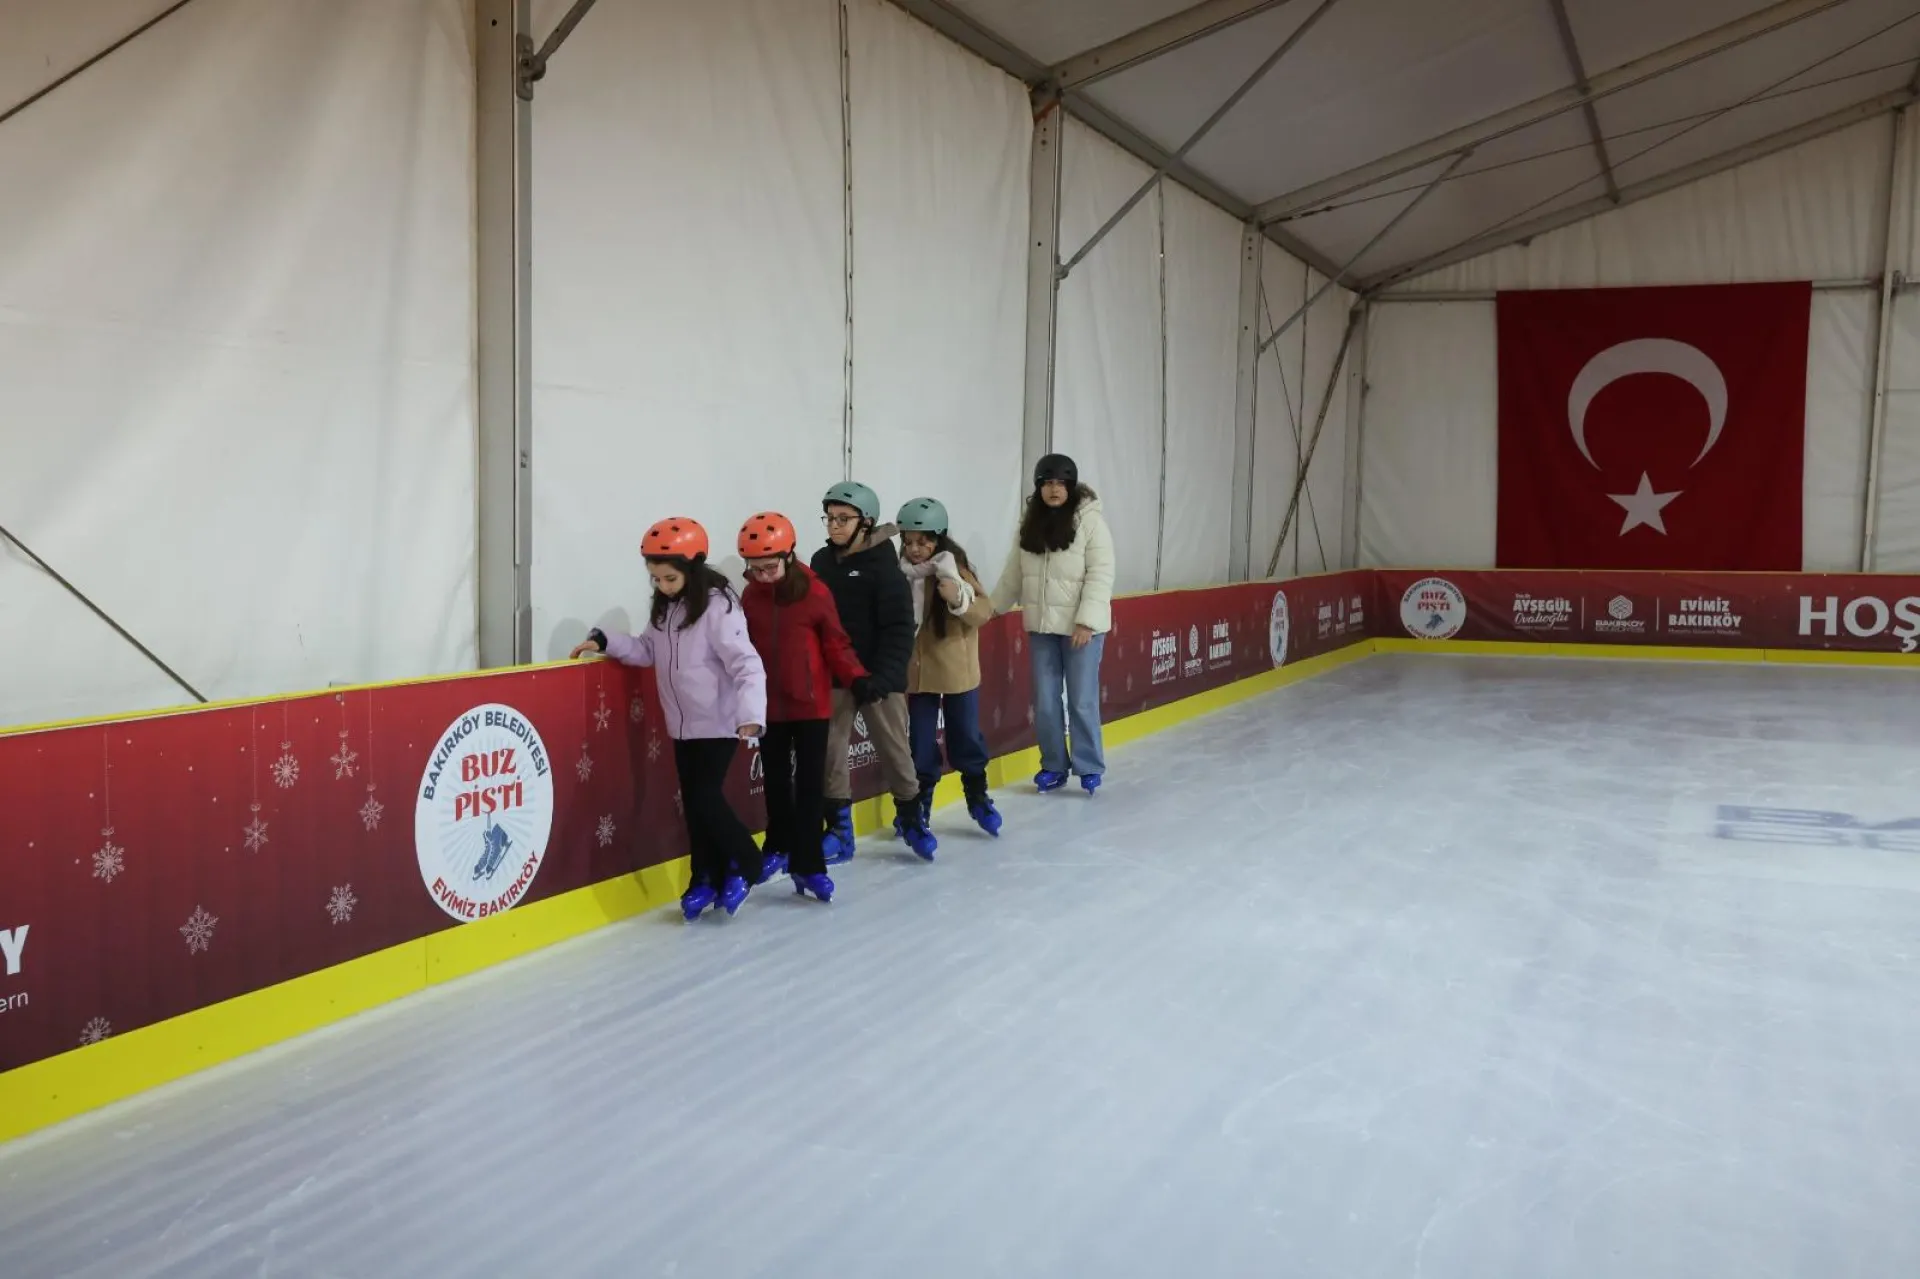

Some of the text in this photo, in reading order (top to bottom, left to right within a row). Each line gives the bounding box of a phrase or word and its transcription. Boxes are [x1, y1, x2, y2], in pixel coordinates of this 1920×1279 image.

[1513, 598, 1572, 614] AYŞEGÜL
[1668, 613, 1742, 628] BAKIRKÖY
[1680, 596, 1730, 612] EVİMİZ
[1798, 596, 1920, 653] HOŞ
[423, 711, 548, 800] BAKIRKÖY BELEDİYESİ
[462, 748, 516, 782] BUZ
[455, 775, 522, 821] PİSTİ
[432, 851, 539, 918] EVİMİZ BAKIRKÖY
